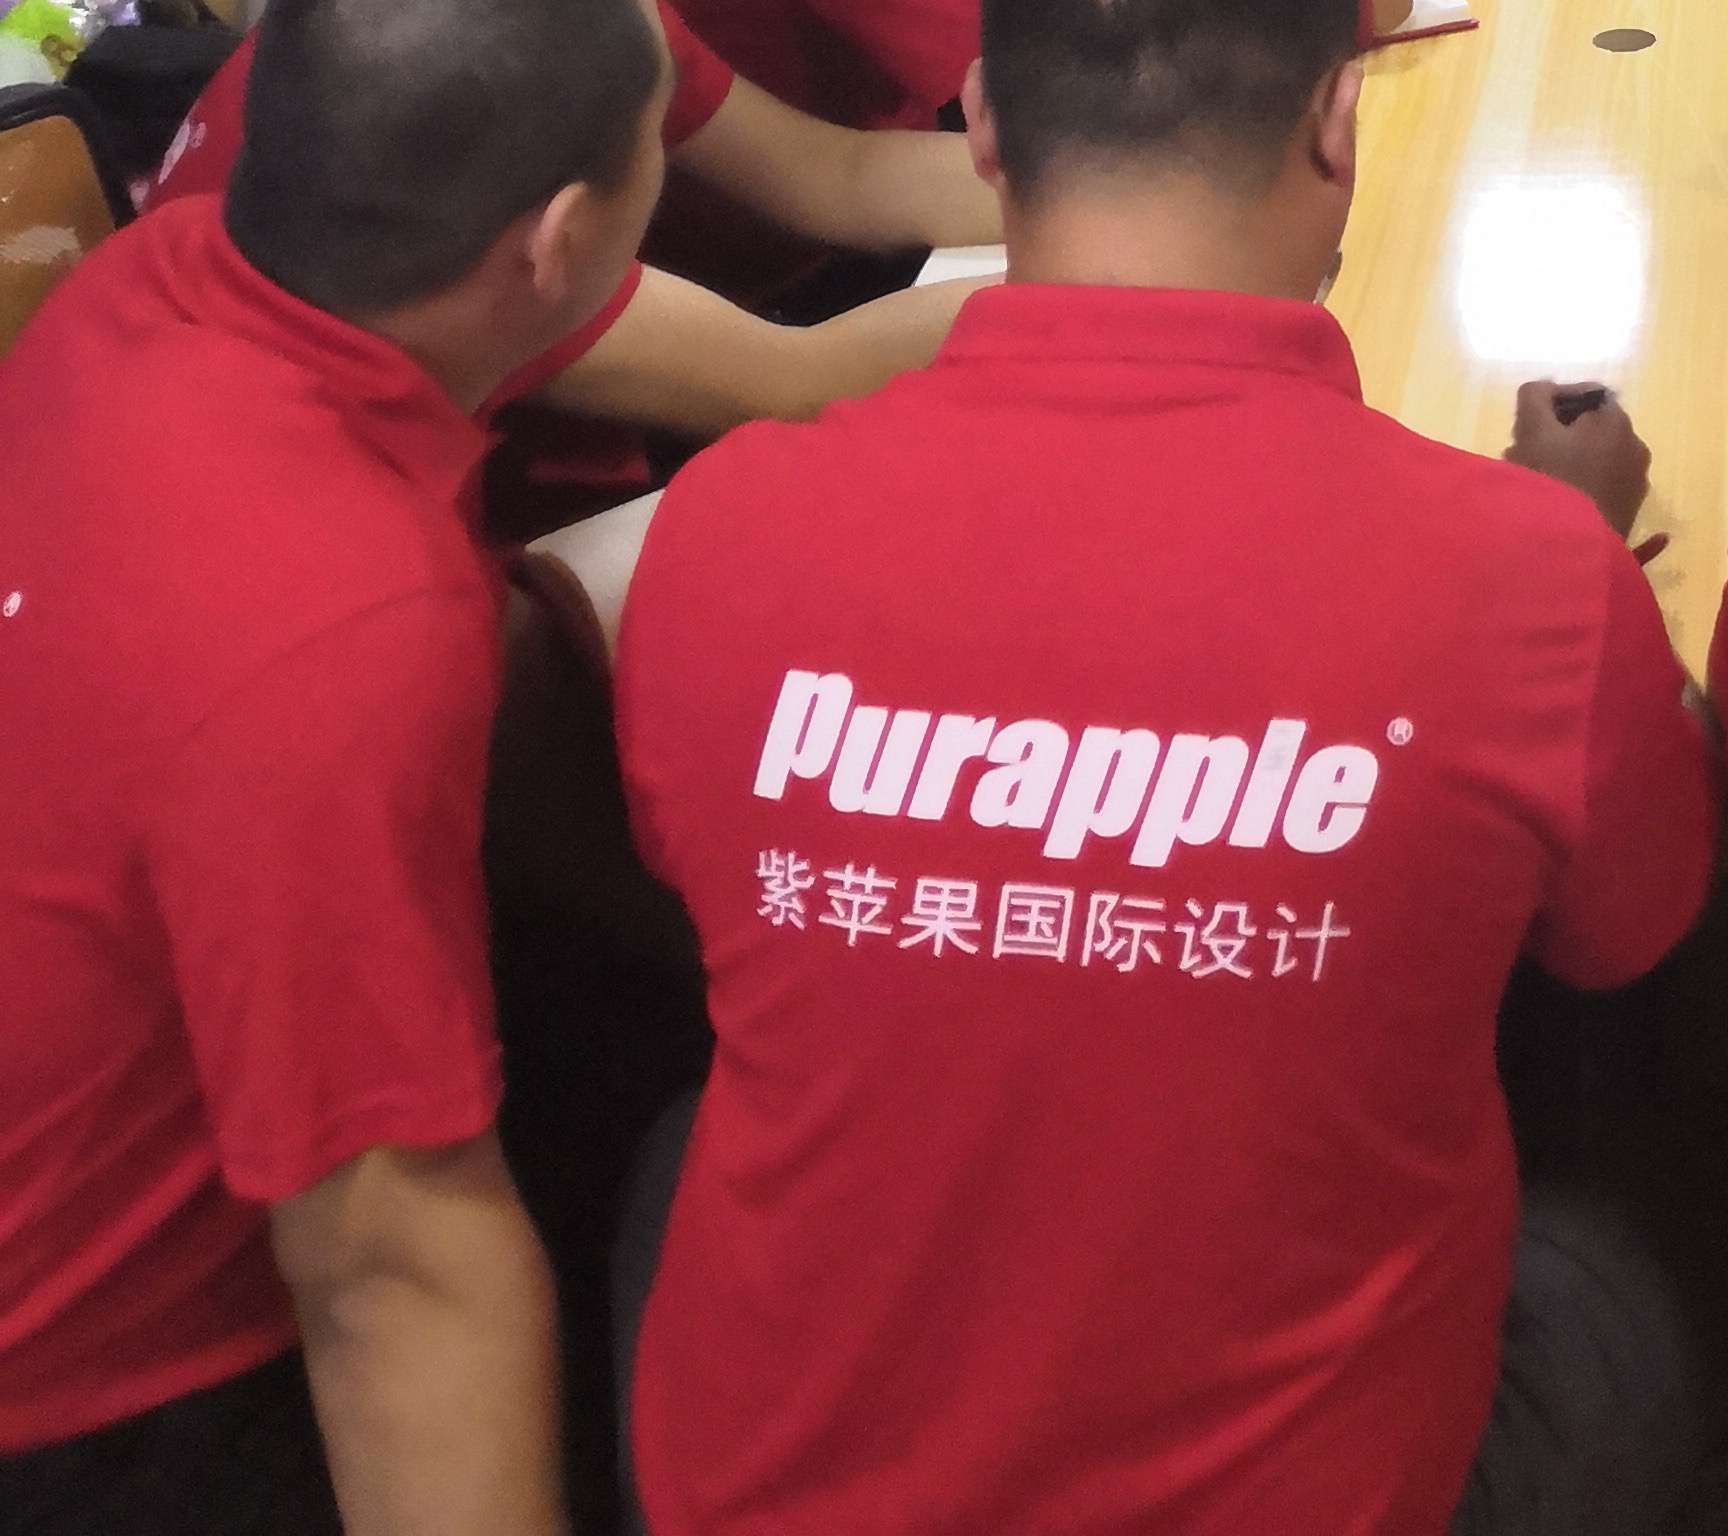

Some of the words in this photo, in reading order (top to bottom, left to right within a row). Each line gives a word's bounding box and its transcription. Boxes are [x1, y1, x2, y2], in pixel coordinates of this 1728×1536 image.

[753, 668, 1380, 868] purapple
[756, 848, 1352, 982] 紫苹果国际设计
